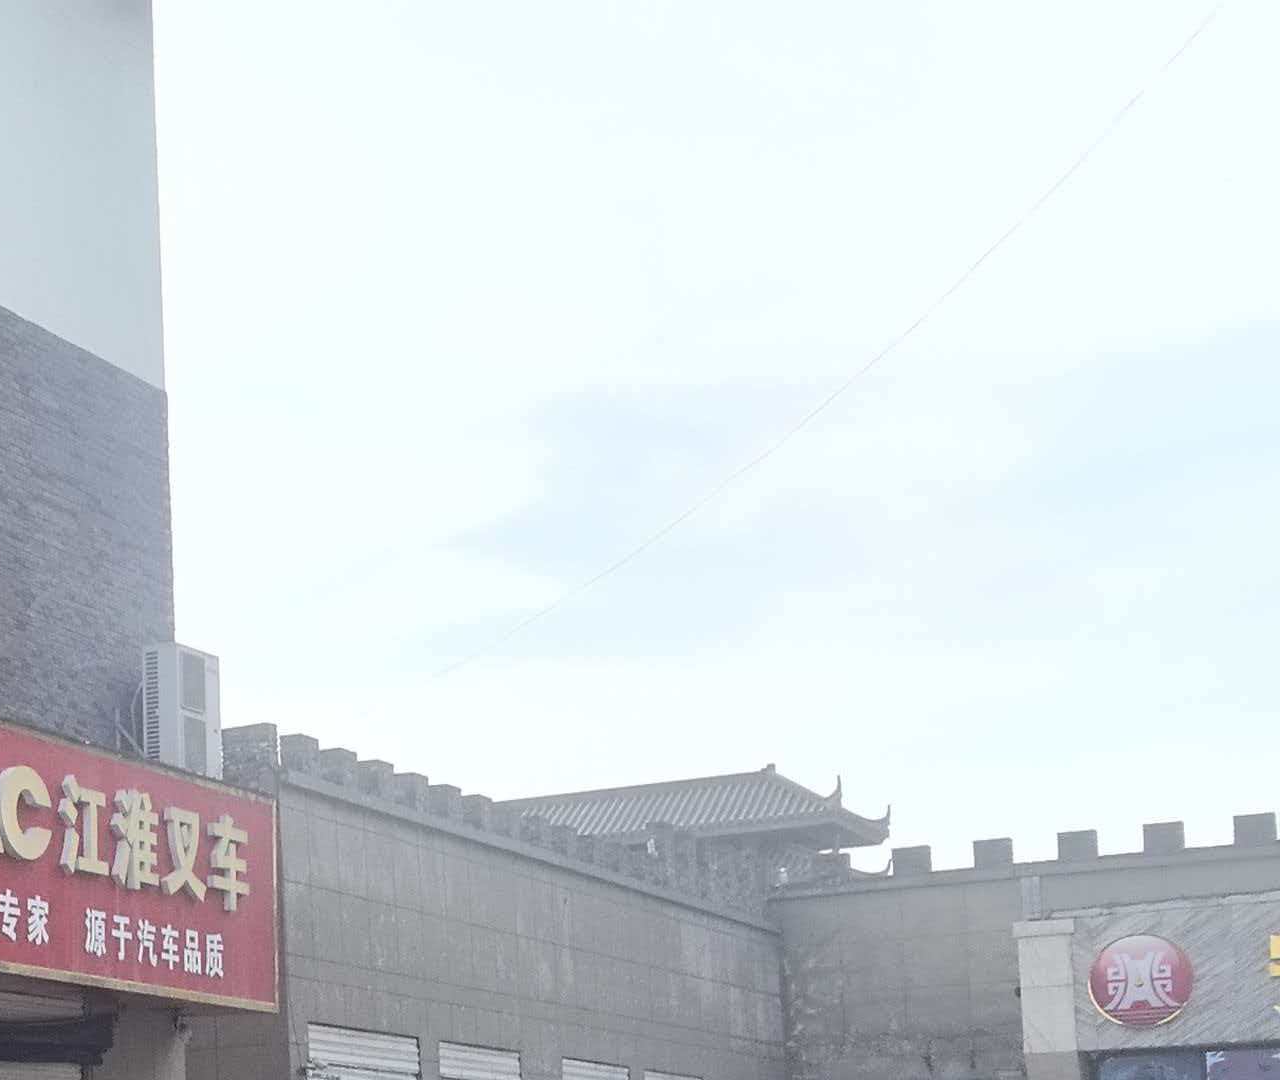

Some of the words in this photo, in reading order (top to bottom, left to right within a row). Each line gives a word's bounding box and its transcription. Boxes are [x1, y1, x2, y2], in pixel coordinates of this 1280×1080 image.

[57, 773, 251, 912] 江淮叉车
[84, 906, 226, 979] 源于汽车品质
